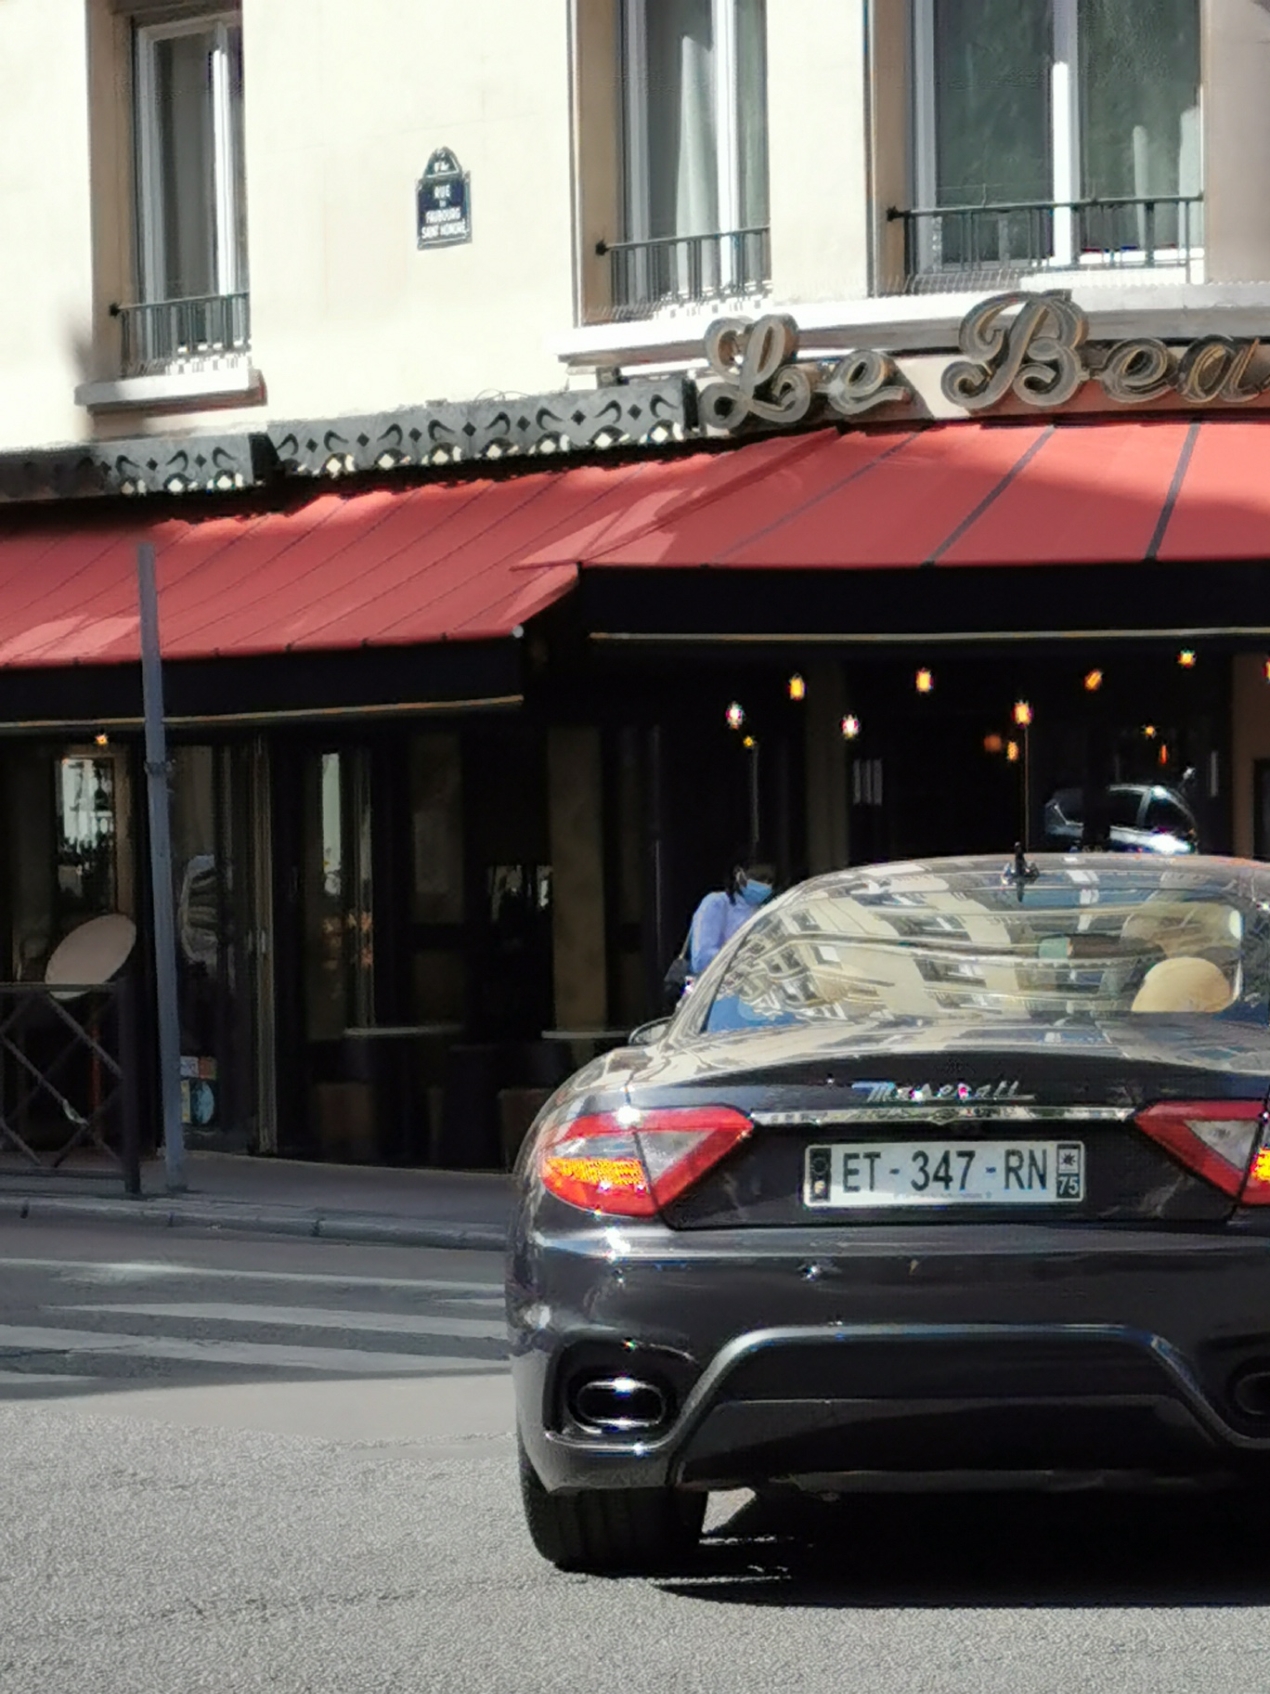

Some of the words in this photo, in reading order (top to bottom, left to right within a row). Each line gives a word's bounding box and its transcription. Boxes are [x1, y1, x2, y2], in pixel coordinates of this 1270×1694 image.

[434, 184, 450, 199] RUE
[700, 313, 911, 429] Le
[1057, 1176, 1079, 1195] 75
